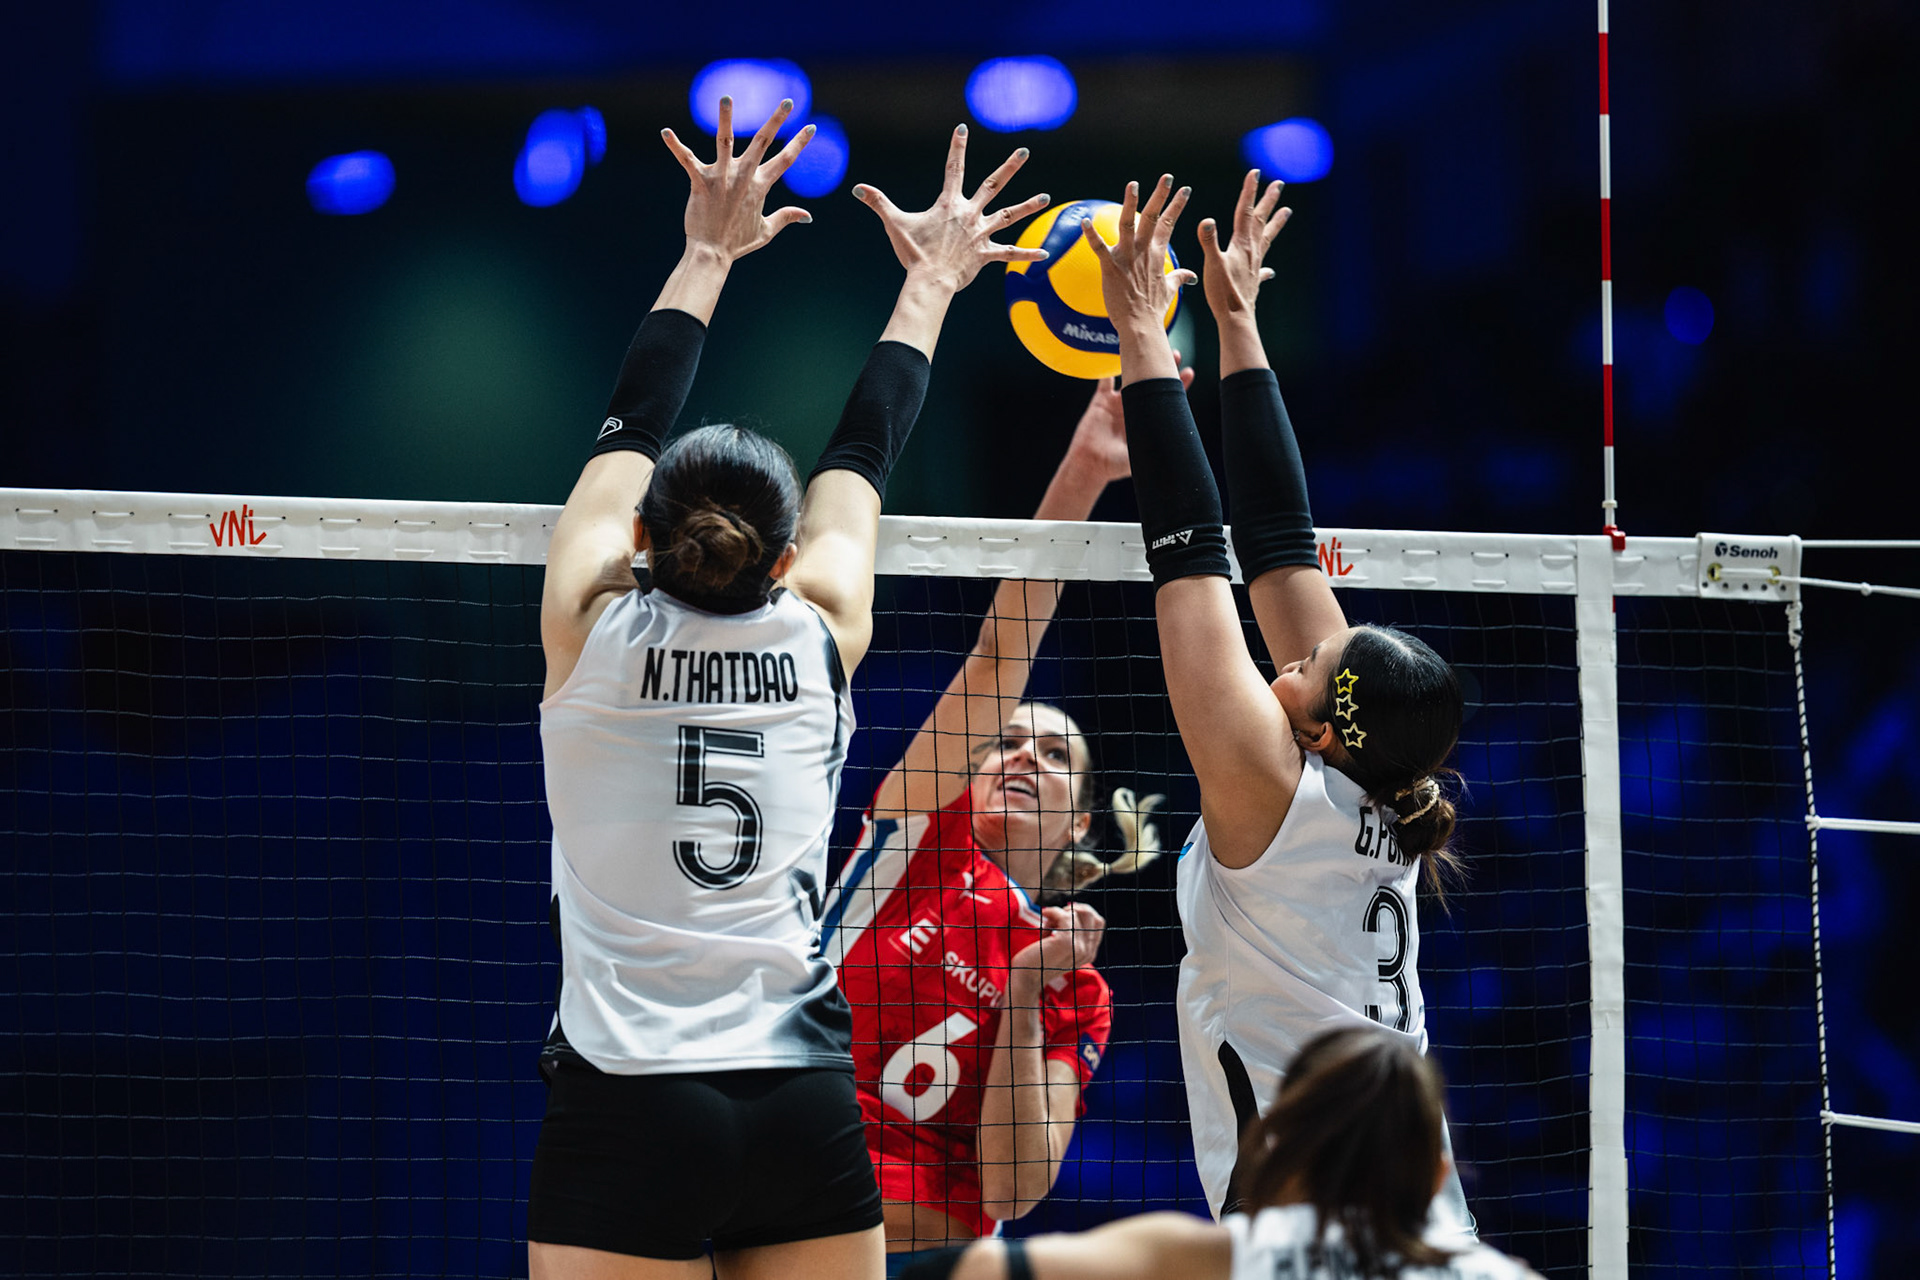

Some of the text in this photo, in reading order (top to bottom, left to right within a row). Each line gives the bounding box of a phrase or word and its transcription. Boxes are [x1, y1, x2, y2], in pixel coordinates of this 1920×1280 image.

[1316, 536, 1354, 577] NL
[1729, 544, 1778, 559] Senoh
[640, 647, 798, 703] N.THATDAO
[673, 725, 764, 890] 5
[1355, 806, 1412, 867] G.PO
[941, 951, 1003, 1007] SKUPI
[1362, 886, 1411, 1033] 3
[879, 1012, 978, 1121] 6
